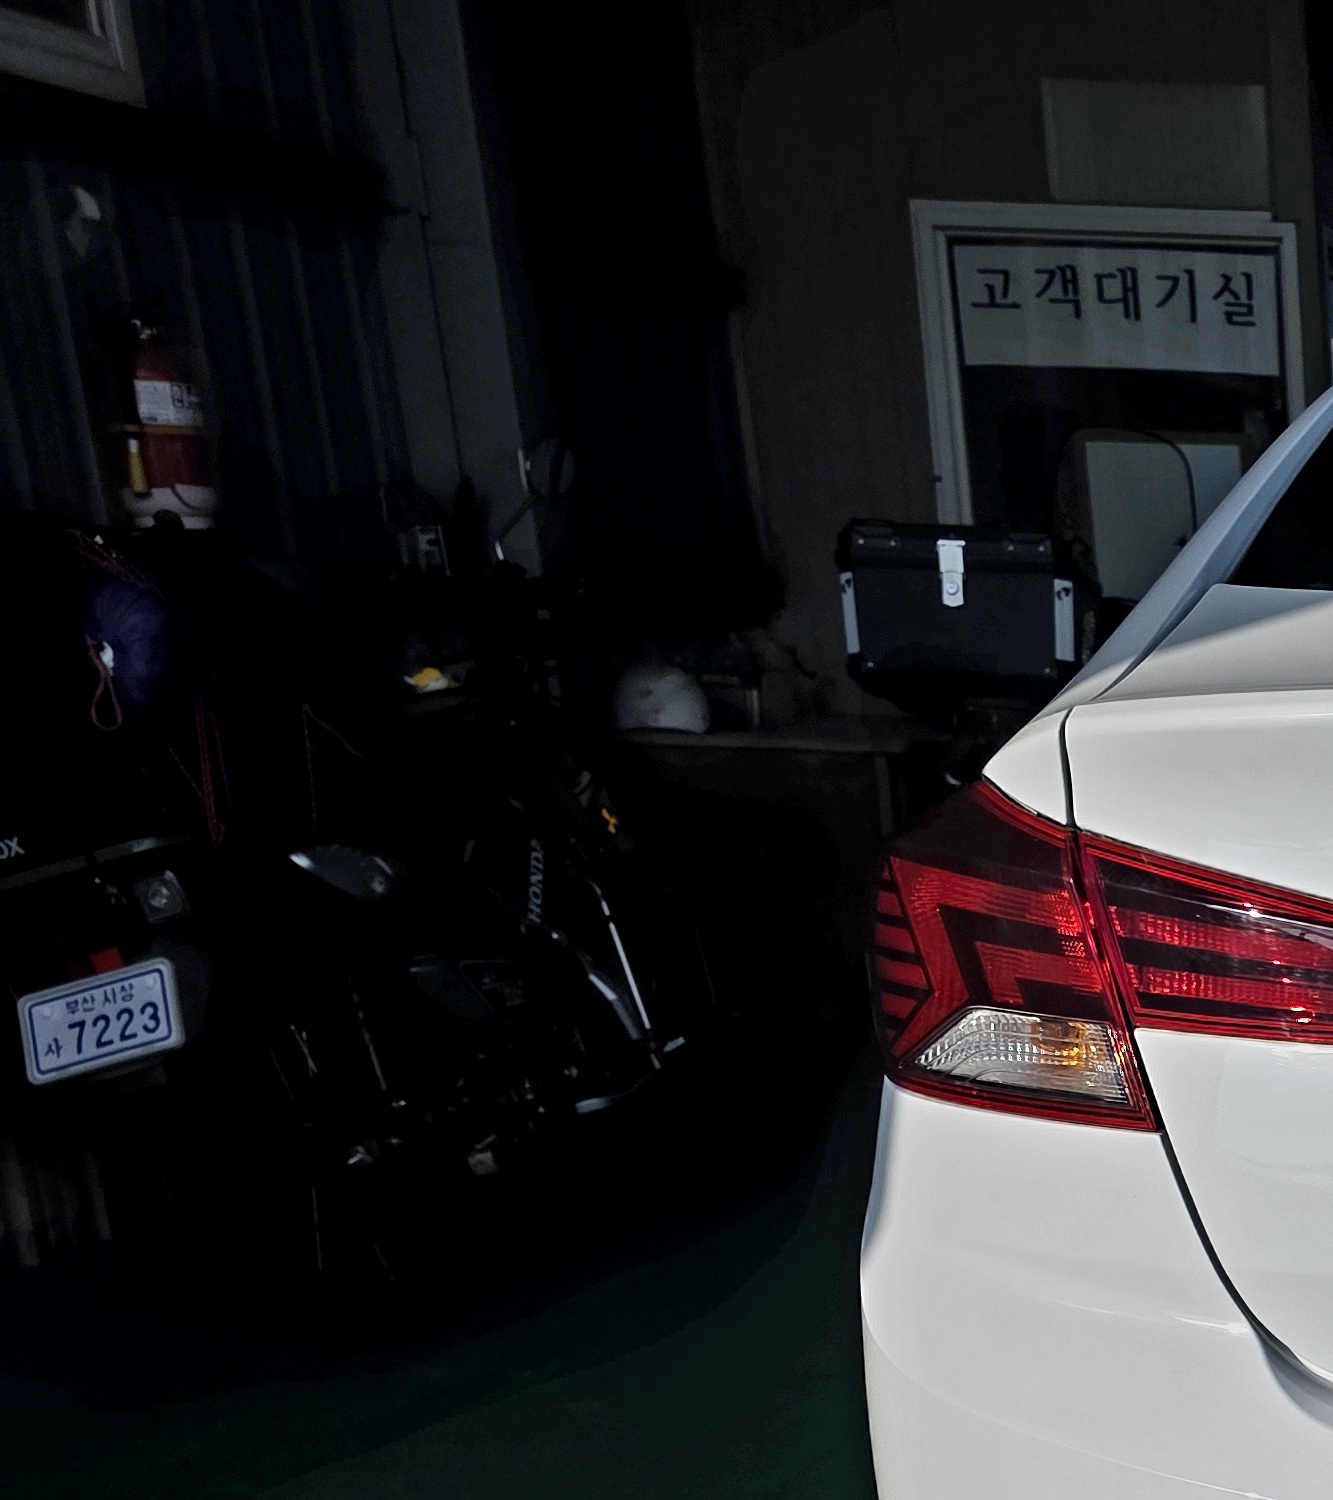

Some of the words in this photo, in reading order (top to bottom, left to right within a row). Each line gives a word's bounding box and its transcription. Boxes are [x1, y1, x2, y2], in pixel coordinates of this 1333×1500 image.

[970, 262, 1257, 327] 고객대기실
[527, 838, 545, 923] HONDA
[44, 1037, 63, 1059] 사
[67, 1001, 161, 1054] 7223
[65, 994, 96, 1015] 부산
